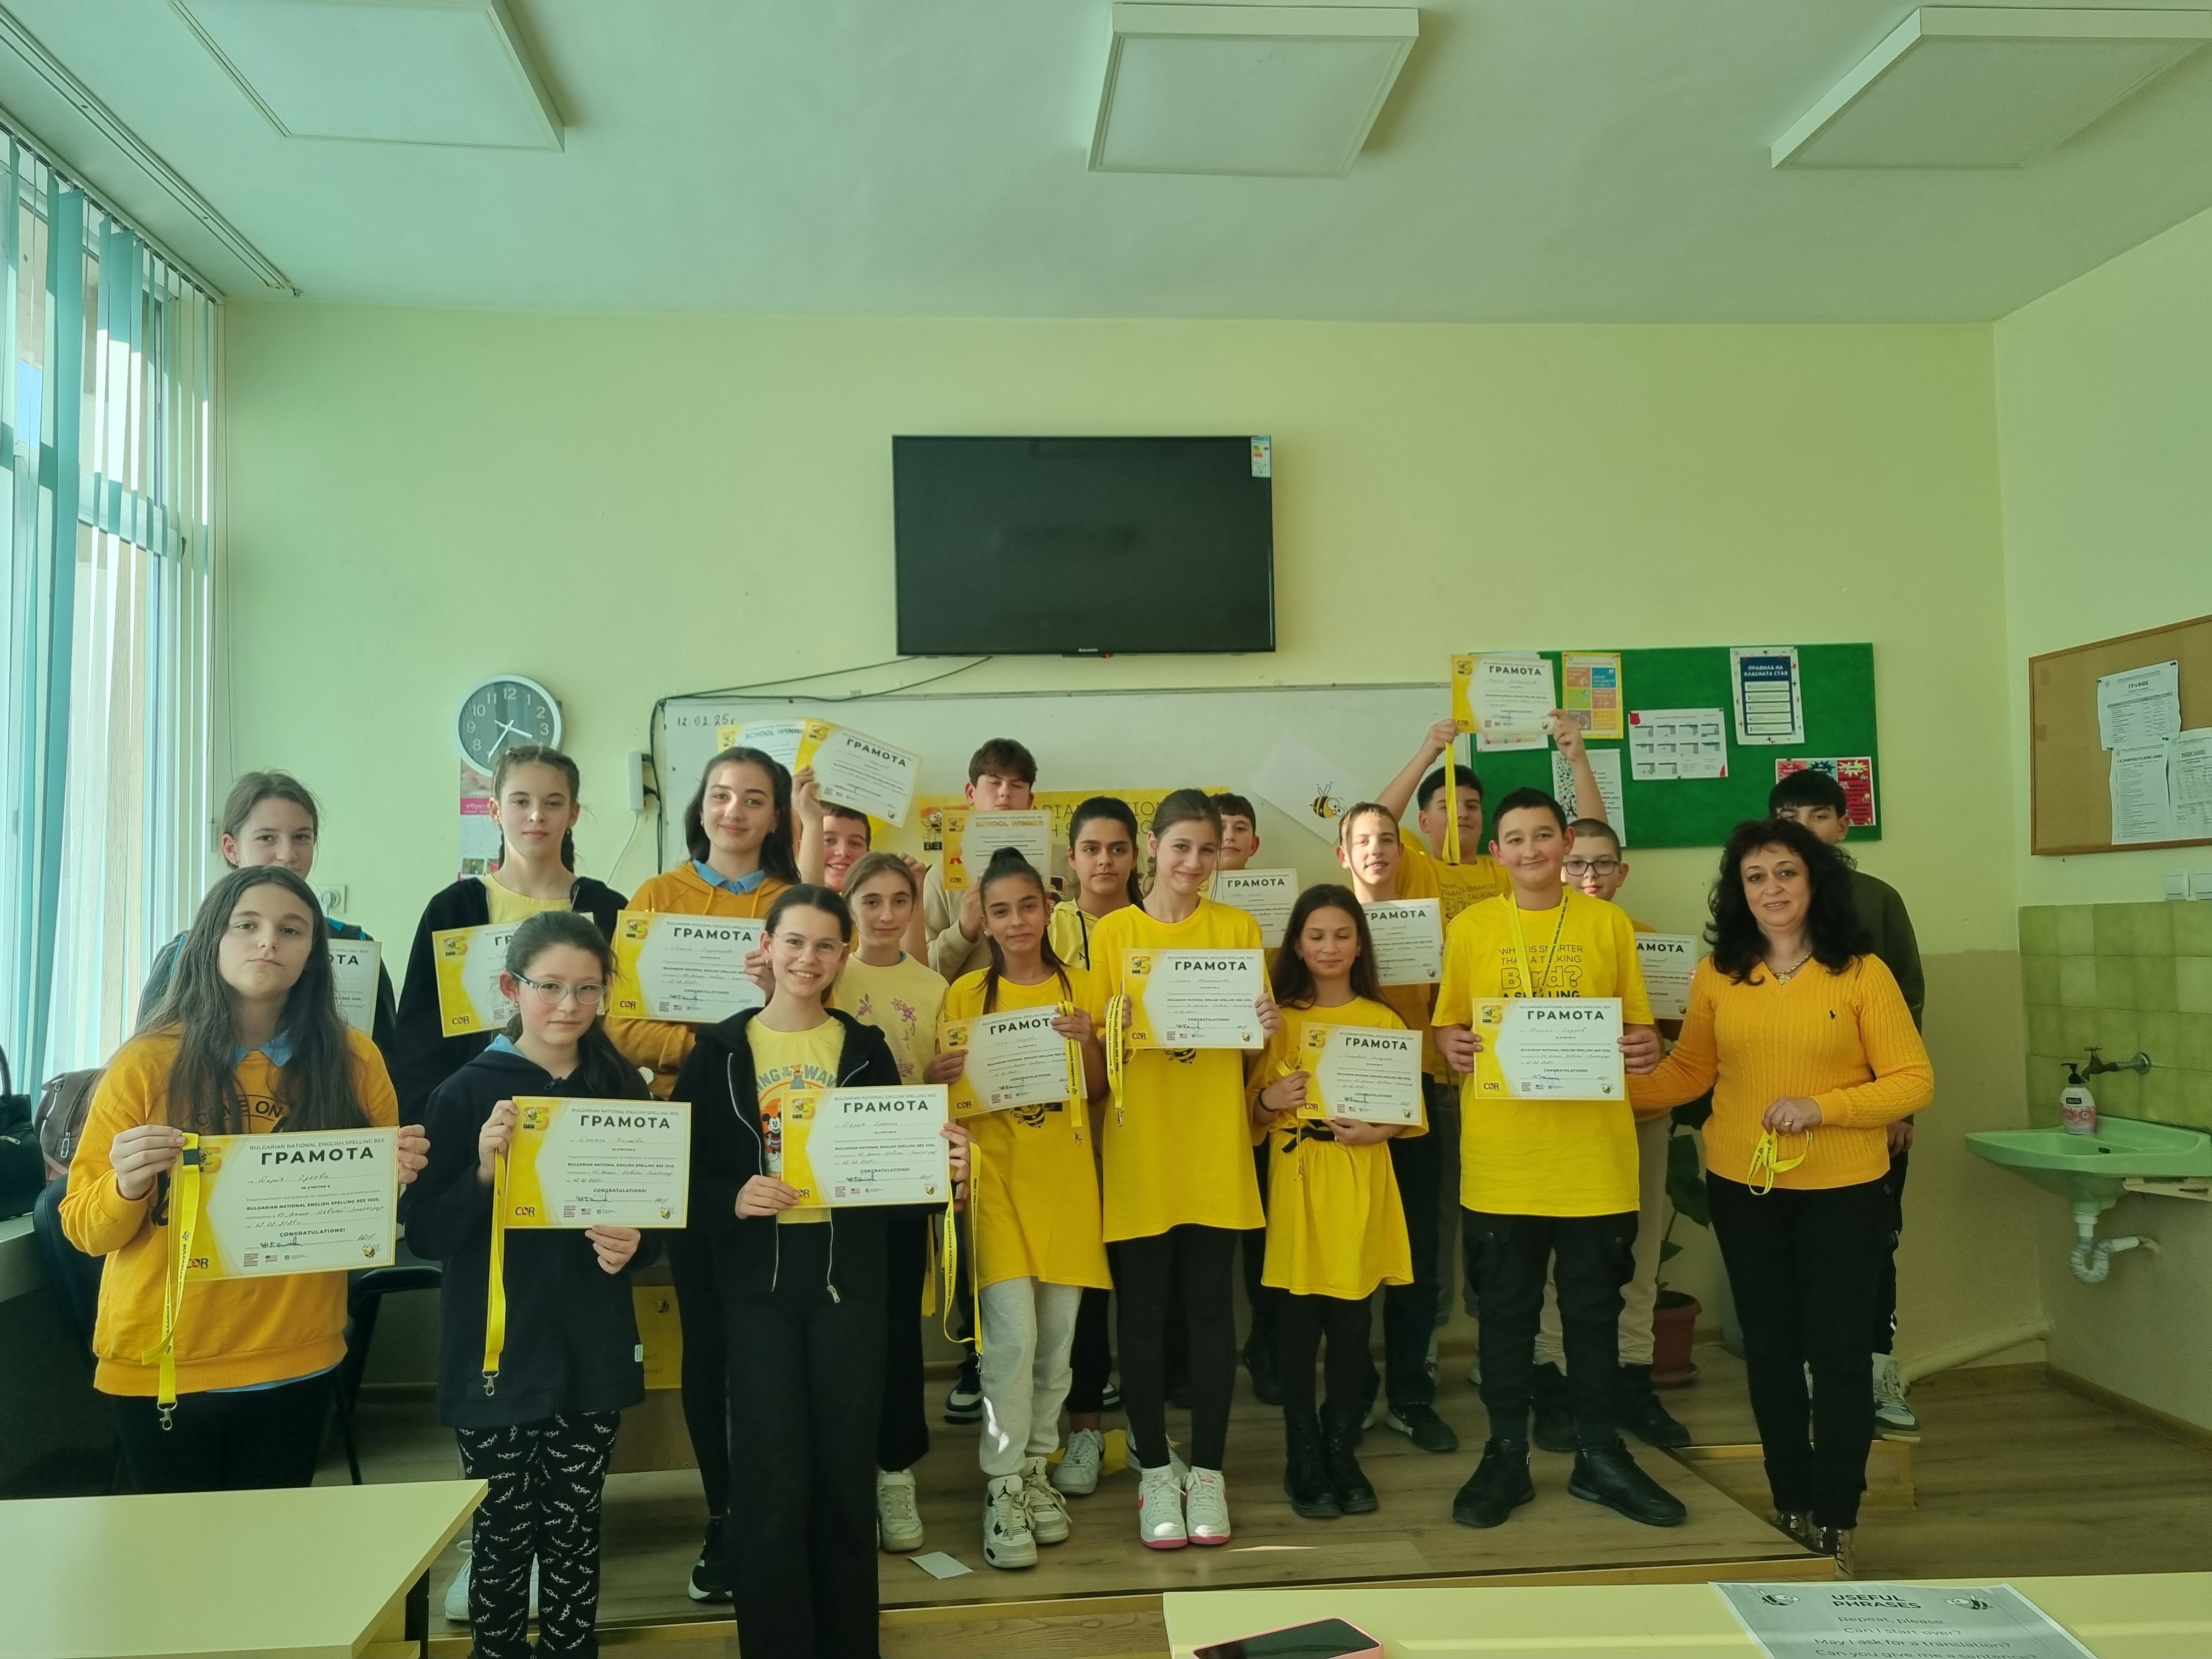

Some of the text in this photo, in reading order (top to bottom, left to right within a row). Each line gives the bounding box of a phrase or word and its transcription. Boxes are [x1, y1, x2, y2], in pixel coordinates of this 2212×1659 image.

[1489, 665, 1541, 675] ГРАМОТА
[2128, 680, 2149, 689] ГРАФИК
[487, 693, 497, 704] 11
[504, 687, 517, 699] 12
[527, 694, 531, 705] 1
[473, 704, 486, 716] 10
[537, 707, 545, 718] 2
[467, 721, 476, 732] 9
[540, 723, 549, 735] 3
[746, 729, 775, 739] SCHOOL
[473, 739, 482, 751] 8
[847, 738, 906, 767] ГРАМОТА
[1228, 878, 1284, 887] ГРАМОТА
[674, 927, 752, 941] ГРАМОТА
[1538, 944, 1583, 953] SMRTER
[1538, 955, 1582, 963] TKING
[1175, 961, 1247, 970] ГРАМОТА
[1500, 965, 1583, 990] Brd?
[620, 1001, 636, 1009] COR
[453, 1015, 469, 1025] COR
[1528, 1011, 1604, 1020] ГРАМОТА
[1346, 1037, 1407, 1050] ГРАМОТА
[843, 1100, 928, 1113] ГРАМОТА
[957, 1101, 972, 1109] COR
[580, 1115, 670, 1128] ГРАМОТА
[261, 1146, 374, 1165] ГРАМОТА
[515, 1206, 535, 1217] COR
[279, 1228, 346, 1238] CONGRATULATIONS!
[1814, 1638, 1846, 1646] May
